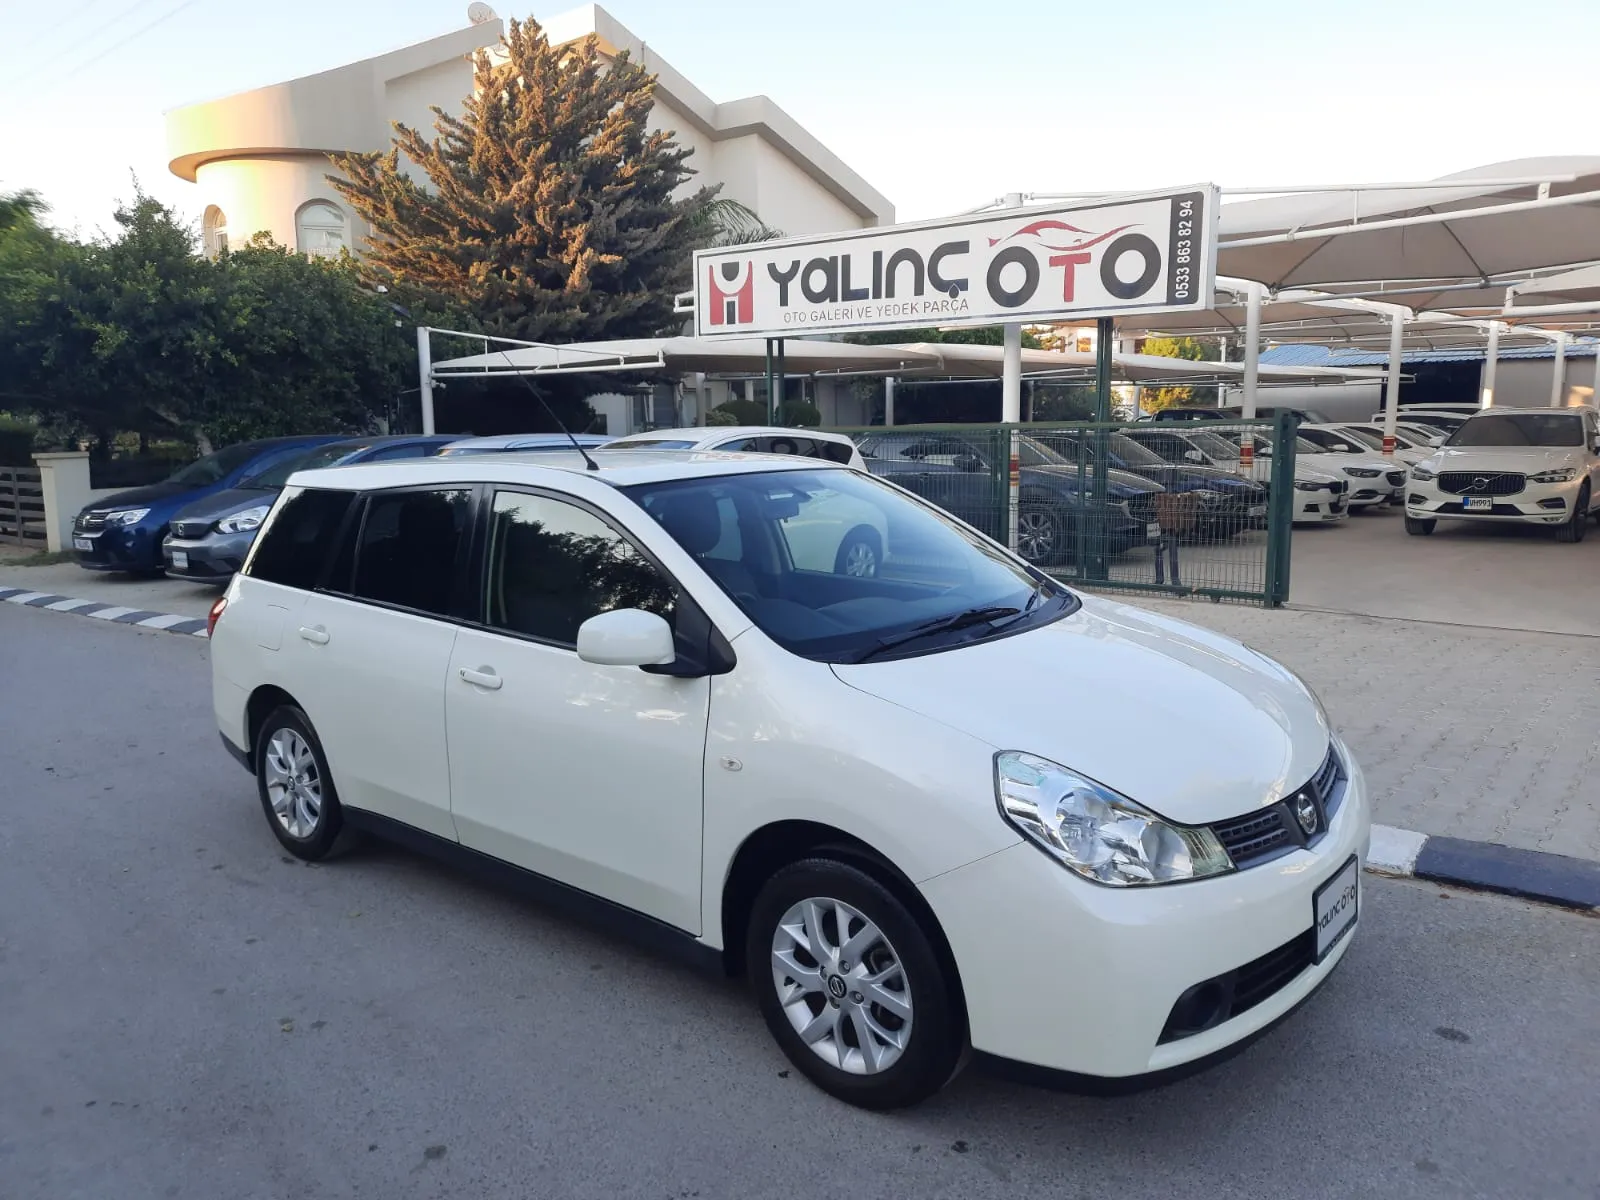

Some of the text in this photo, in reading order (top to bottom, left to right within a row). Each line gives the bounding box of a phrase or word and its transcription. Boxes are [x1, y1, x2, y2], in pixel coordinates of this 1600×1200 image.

[986, 233, 1162, 308] OTO
[1175, 200, 1193, 298] 0533 863 82 94
[784, 299, 969, 324] OTO GALERİ VE YEDEK PARÇA
